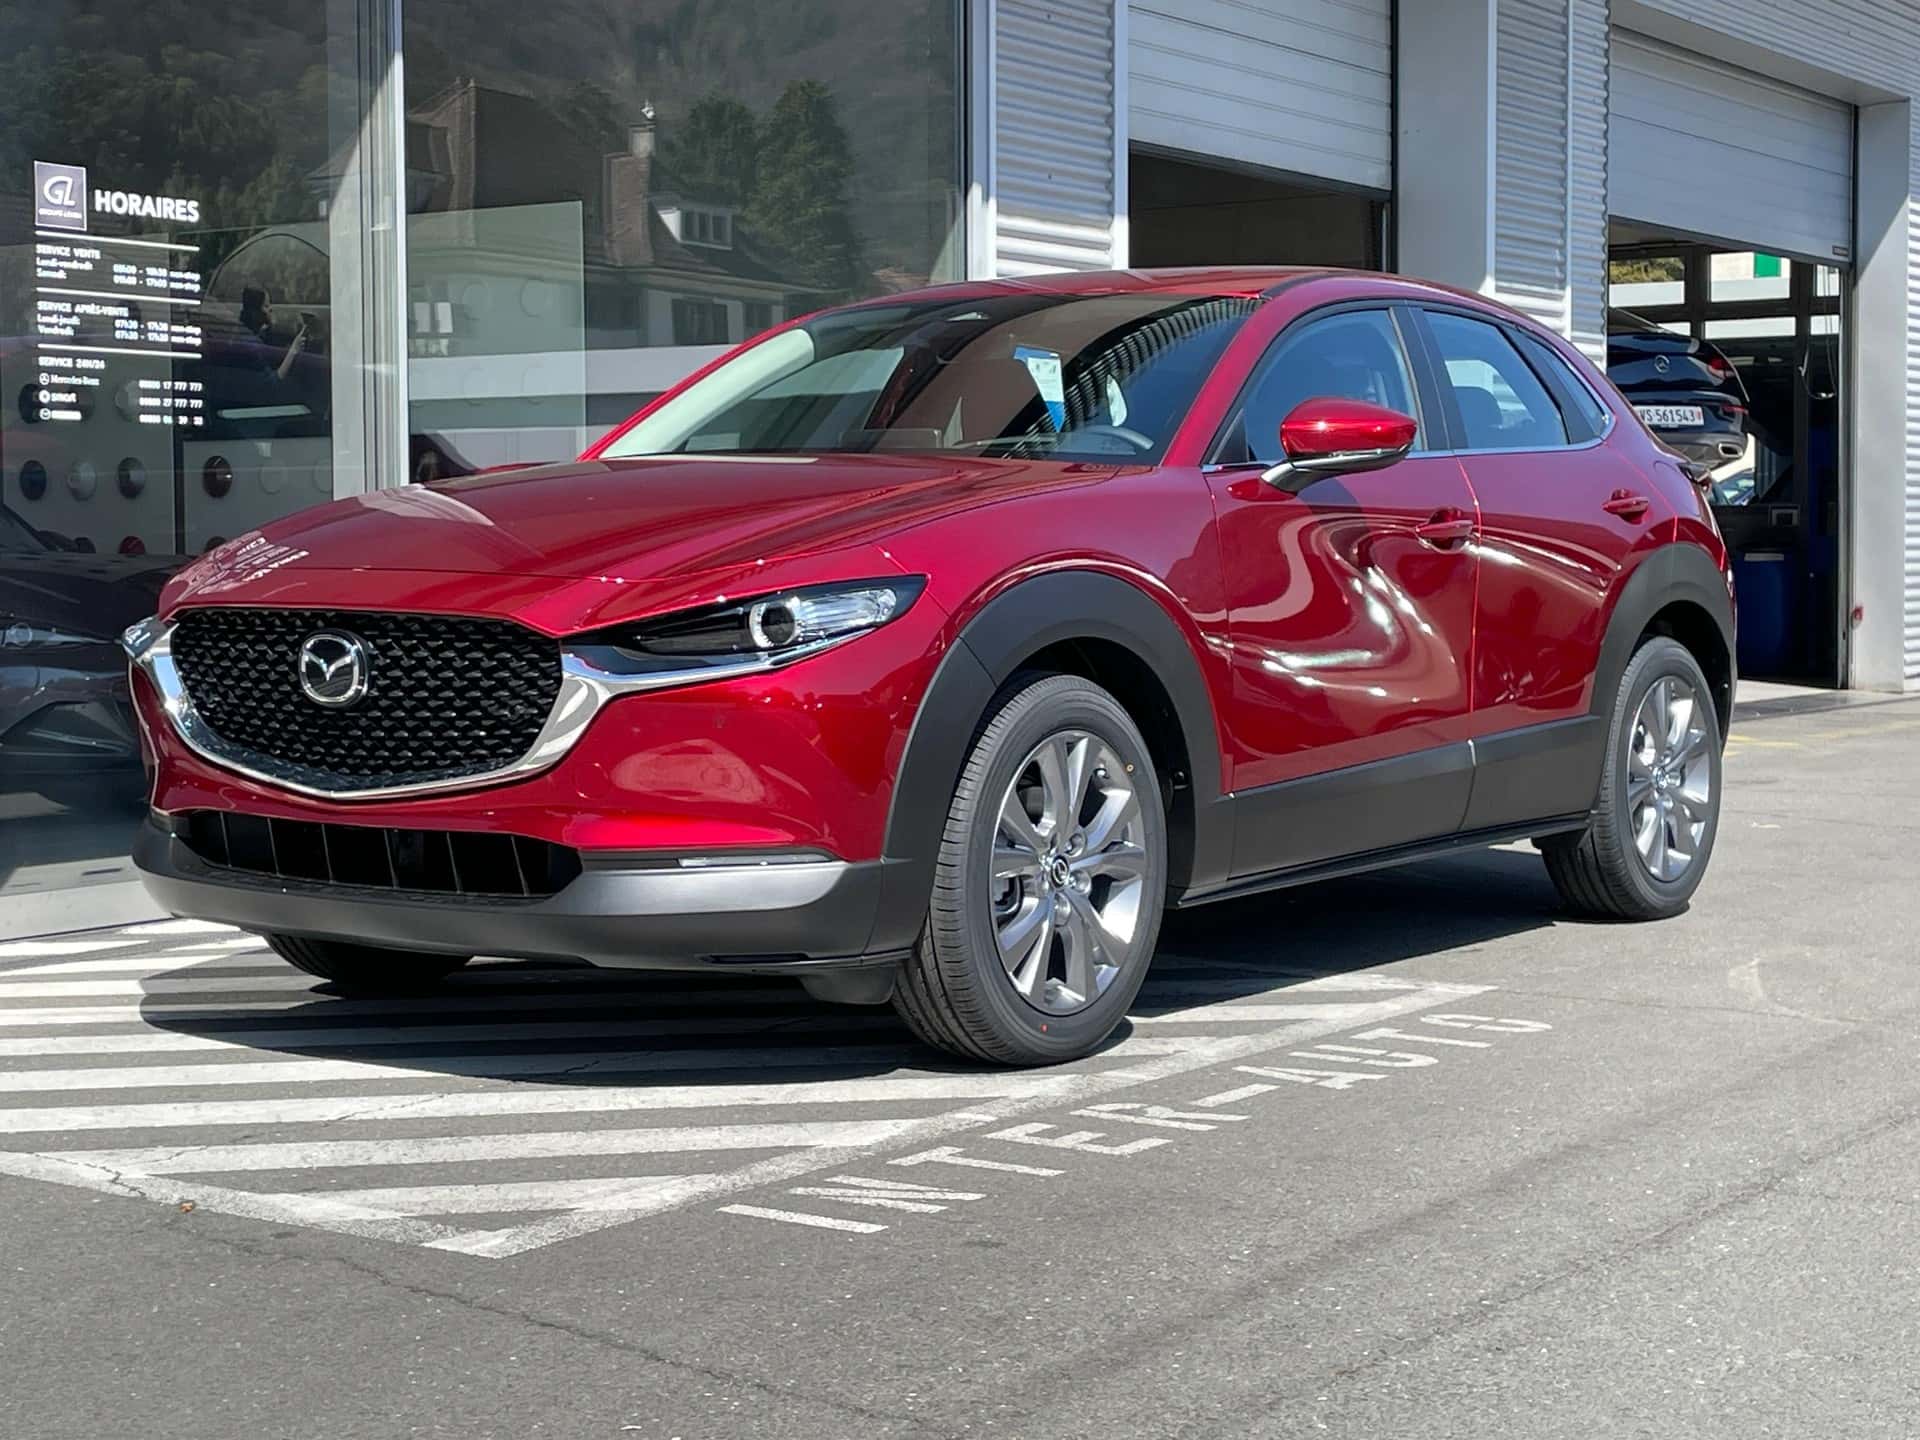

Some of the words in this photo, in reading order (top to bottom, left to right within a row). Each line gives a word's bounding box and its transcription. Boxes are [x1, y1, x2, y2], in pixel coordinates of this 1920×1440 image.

[94, 188, 200, 224] HORAIRES
[36, 243, 70, 257] SERVICE
[73, 247, 101, 260] VENTE
[37, 300, 72, 313] SERVICE
[38, 355, 73, 368] SERVICE
[716, 1013, 1553, 1234] INTER-AUTO
